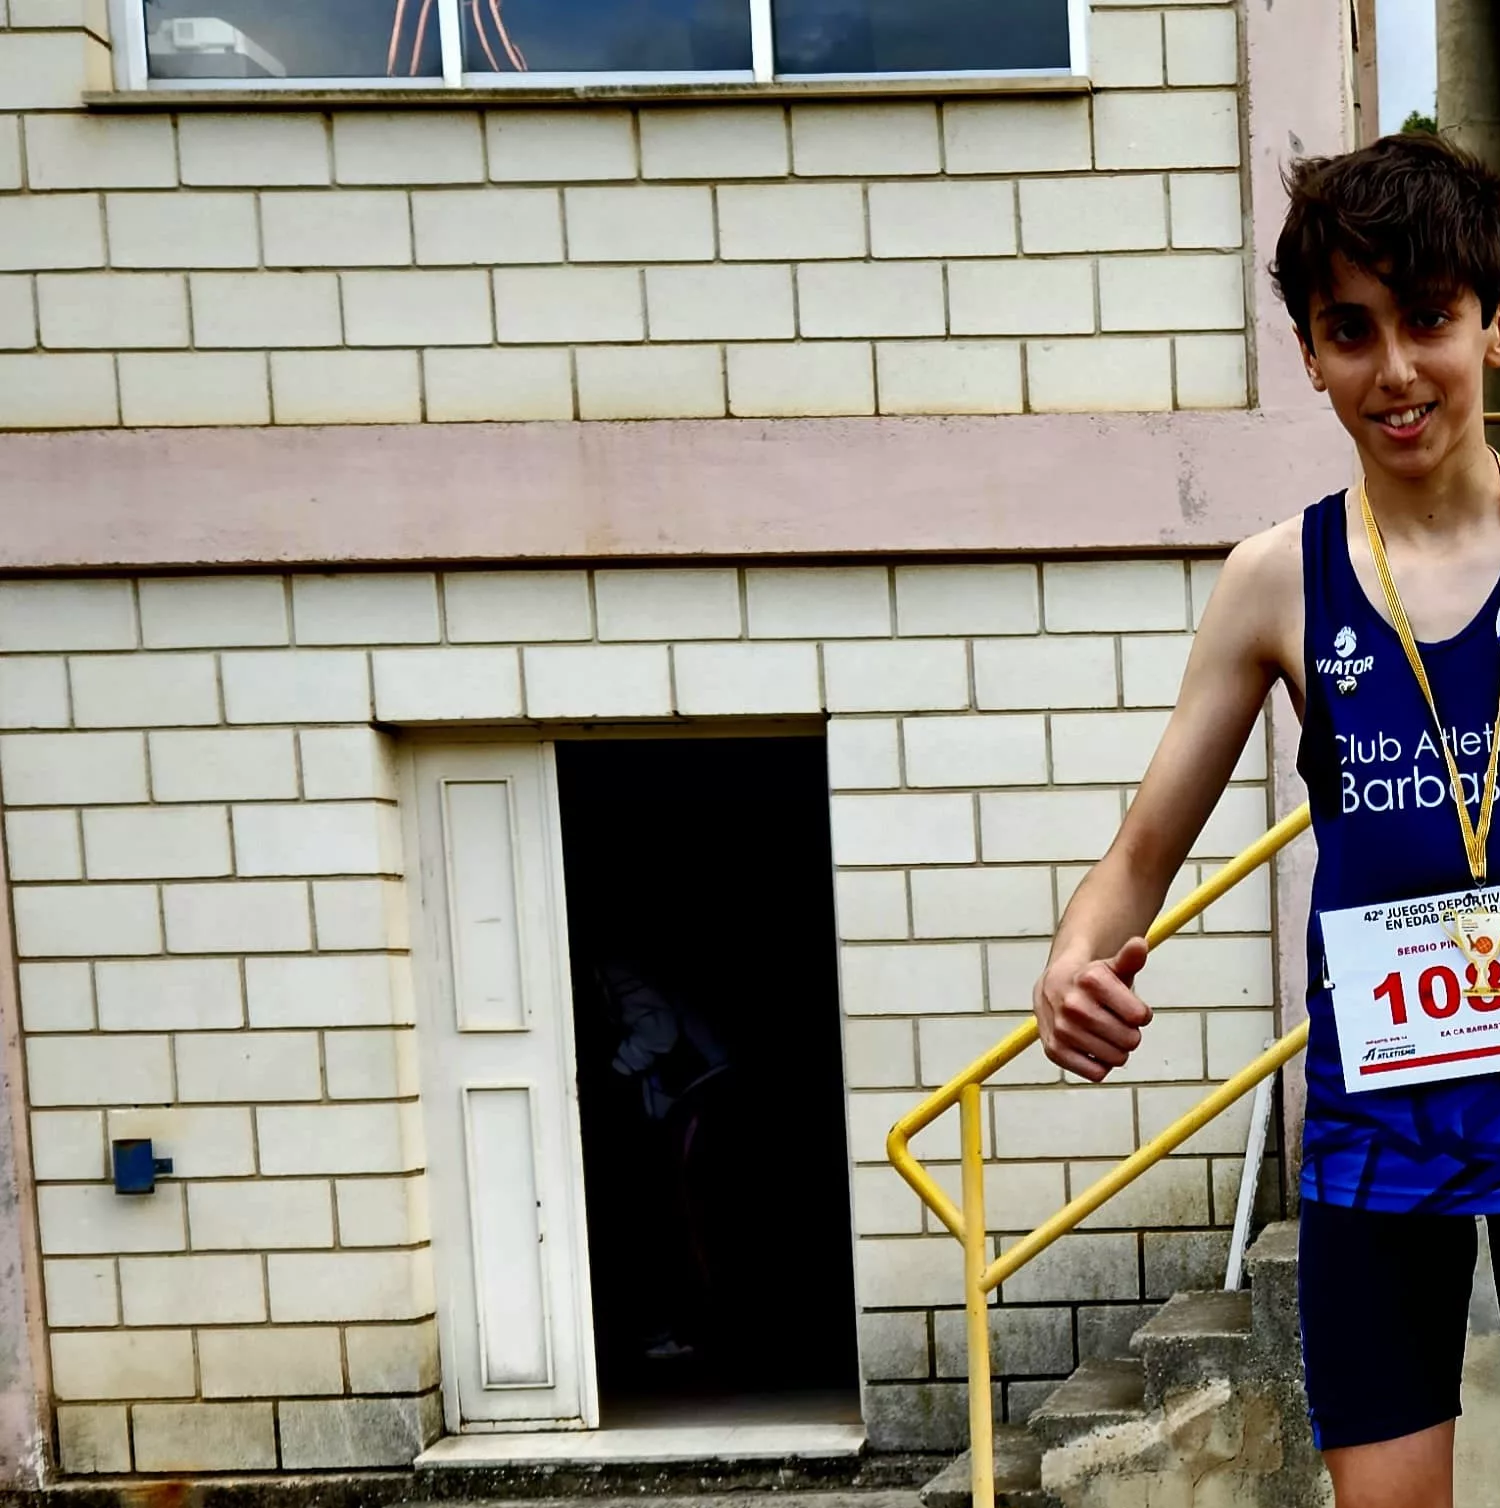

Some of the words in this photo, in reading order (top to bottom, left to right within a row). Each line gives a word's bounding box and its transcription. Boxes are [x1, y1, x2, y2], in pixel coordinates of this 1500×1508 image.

[1316, 655, 1374, 676] VIATOR
[1387, 902, 1435, 920] JUEGOS
[1385, 919, 1403, 931] EN
[1406, 913, 1440, 928] EDAD
[1397, 942, 1437, 957] SERGIO
[1377, 1048, 1416, 1060] ATLETISMO
